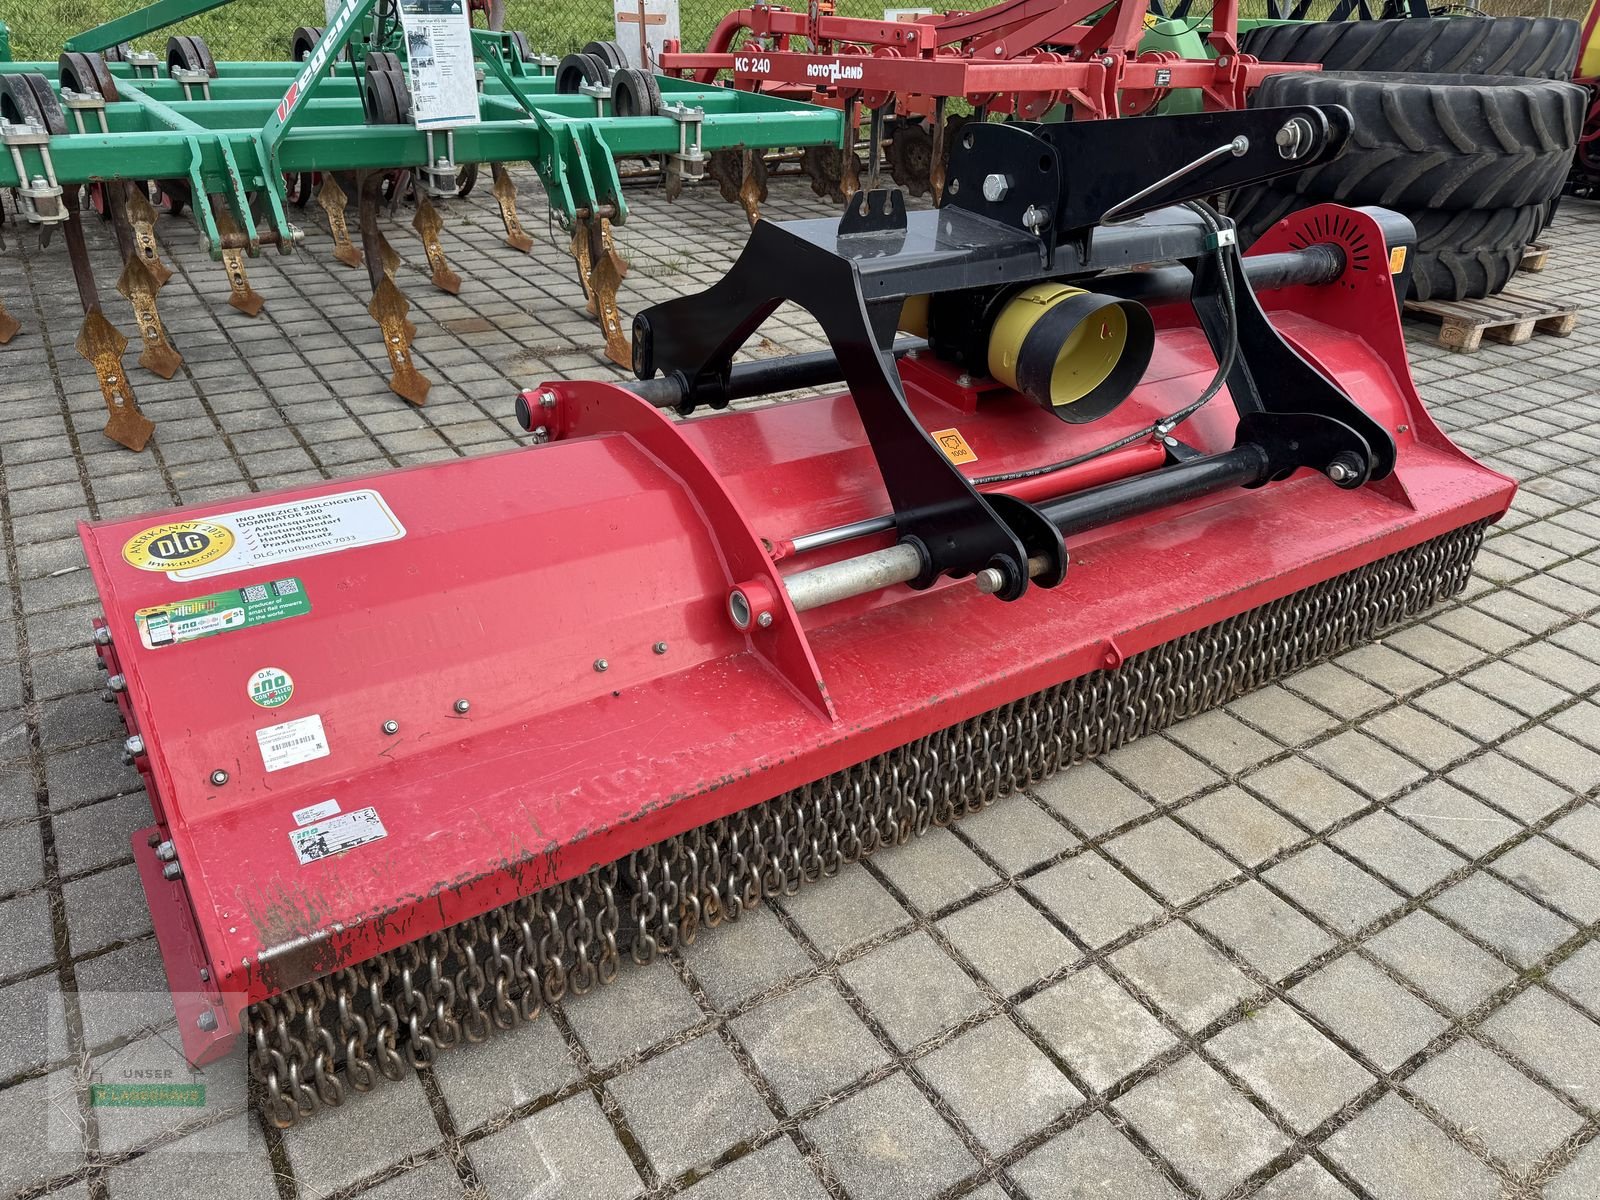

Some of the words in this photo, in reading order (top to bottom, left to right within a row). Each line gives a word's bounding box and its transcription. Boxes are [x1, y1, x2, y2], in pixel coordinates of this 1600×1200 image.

[735, 57, 749, 72] KC
[751, 58, 771, 73] 240
[951, 449, 967, 457] 1000
[236, 514, 256, 523] INO
[257, 507, 299, 520] BREZICE
[301, 494, 369, 512] MULCHGERÄT
[238, 511, 303, 529] DOMINATOR
[304, 508, 323, 517] 280
[254, 513, 333, 532] Arbeitsqualität
[256, 517, 342, 538] Leistungsbedarf
[129, 523, 201, 554] ANERKANNT
[201, 525, 226, 539] 2019
[259, 526, 329, 544] Handhabung
[262, 531, 334, 549] Praxiseinsatz
[157, 532, 203, 557] DLG
[253, 540, 332, 560] DLG-Prüfbericht
[335, 534, 357, 544] 7033
[248, 600, 275, 611] producer
[248, 607, 266, 616] smart
[279, 600, 303, 609] mowers
[177, 621, 197, 631] ino
[177, 627, 201, 635] vibration
[201, 622, 220, 630] control
[257, 669, 275, 679] O.K.
[253, 675, 286, 694] ino
[296, 827, 319, 840] ino
